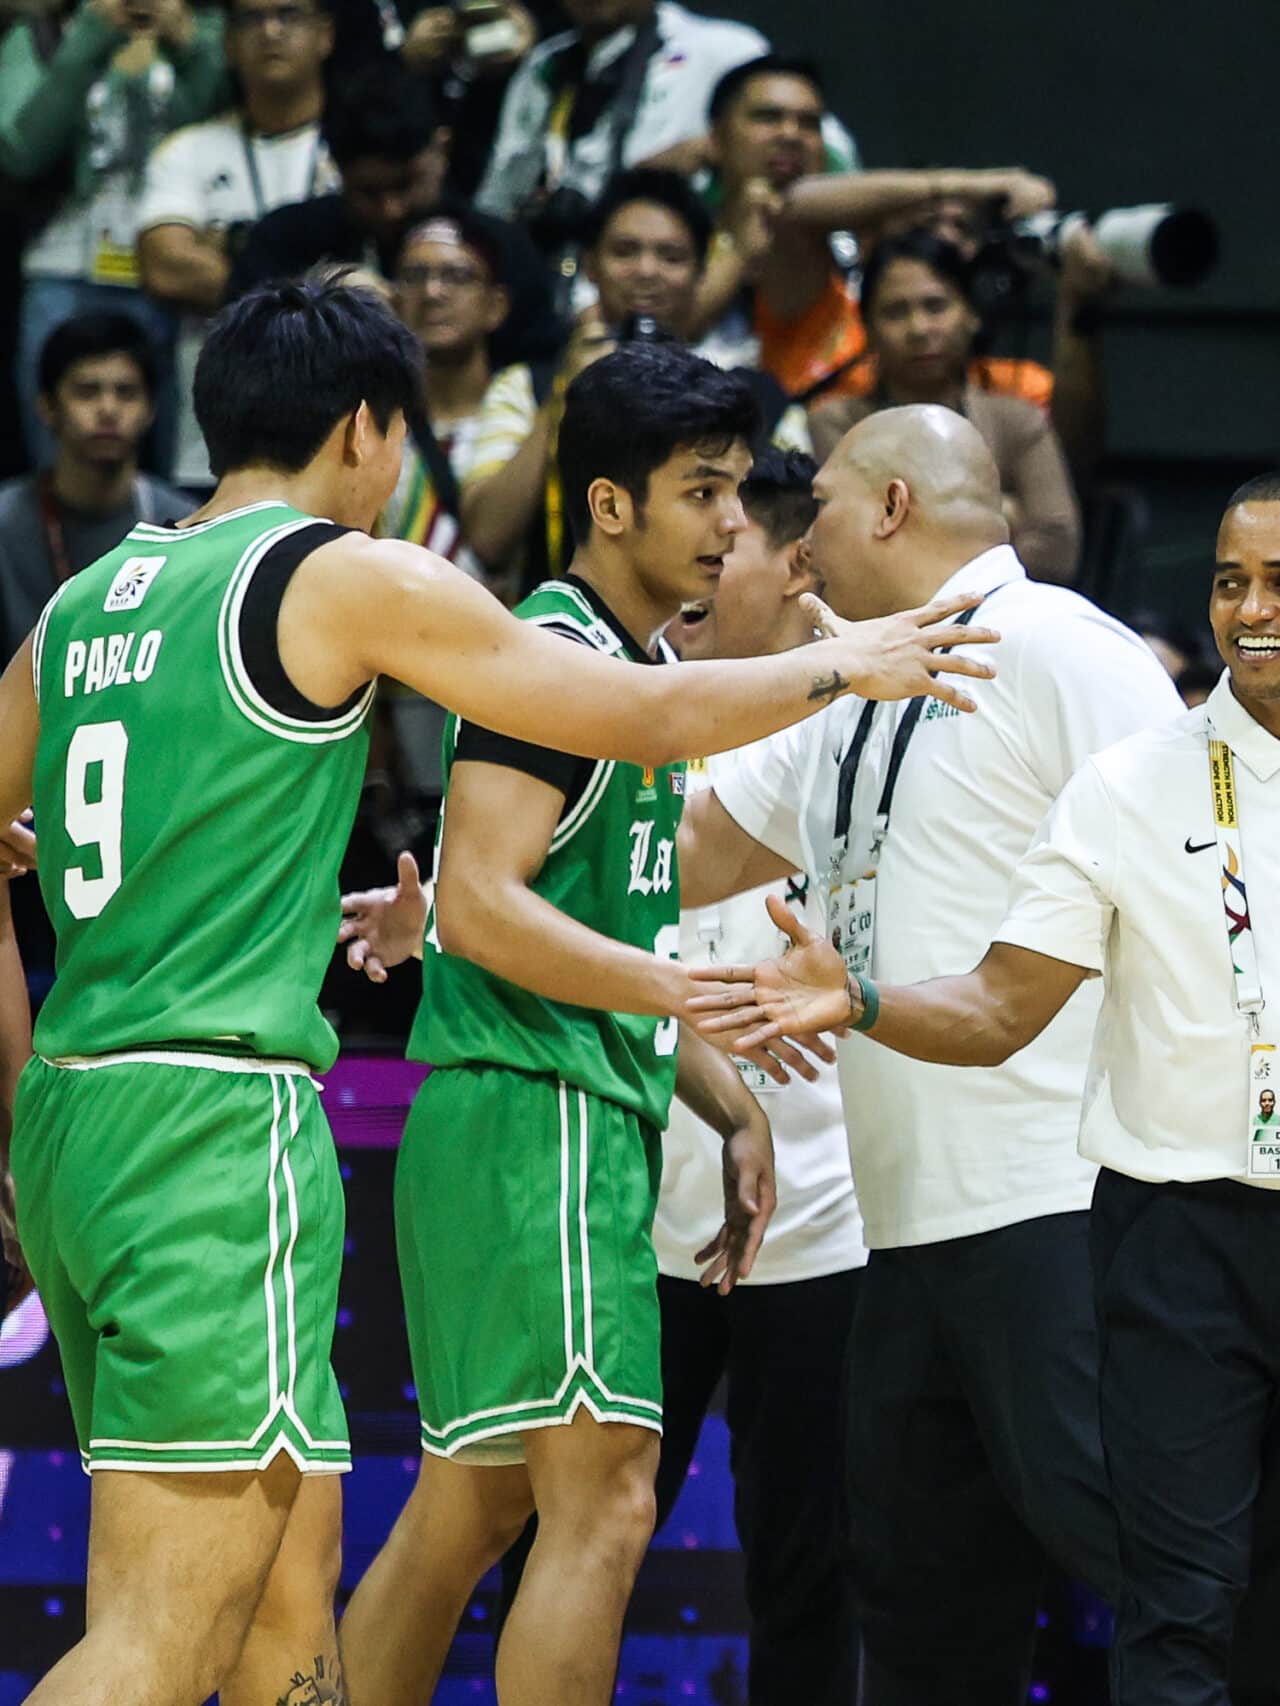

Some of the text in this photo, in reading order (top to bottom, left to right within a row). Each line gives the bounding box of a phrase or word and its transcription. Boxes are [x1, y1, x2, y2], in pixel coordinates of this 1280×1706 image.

[64, 629, 164, 698] PABLO
[1212, 760, 1224, 822] HOPE IN ACTION
[1222, 744, 1231, 780] STRENGTH
[1225, 782, 1232, 790] IN
[64, 719, 130, 921] 9
[628, 819, 674, 896] La
[1274, 1158, 1280, 1170] 1
